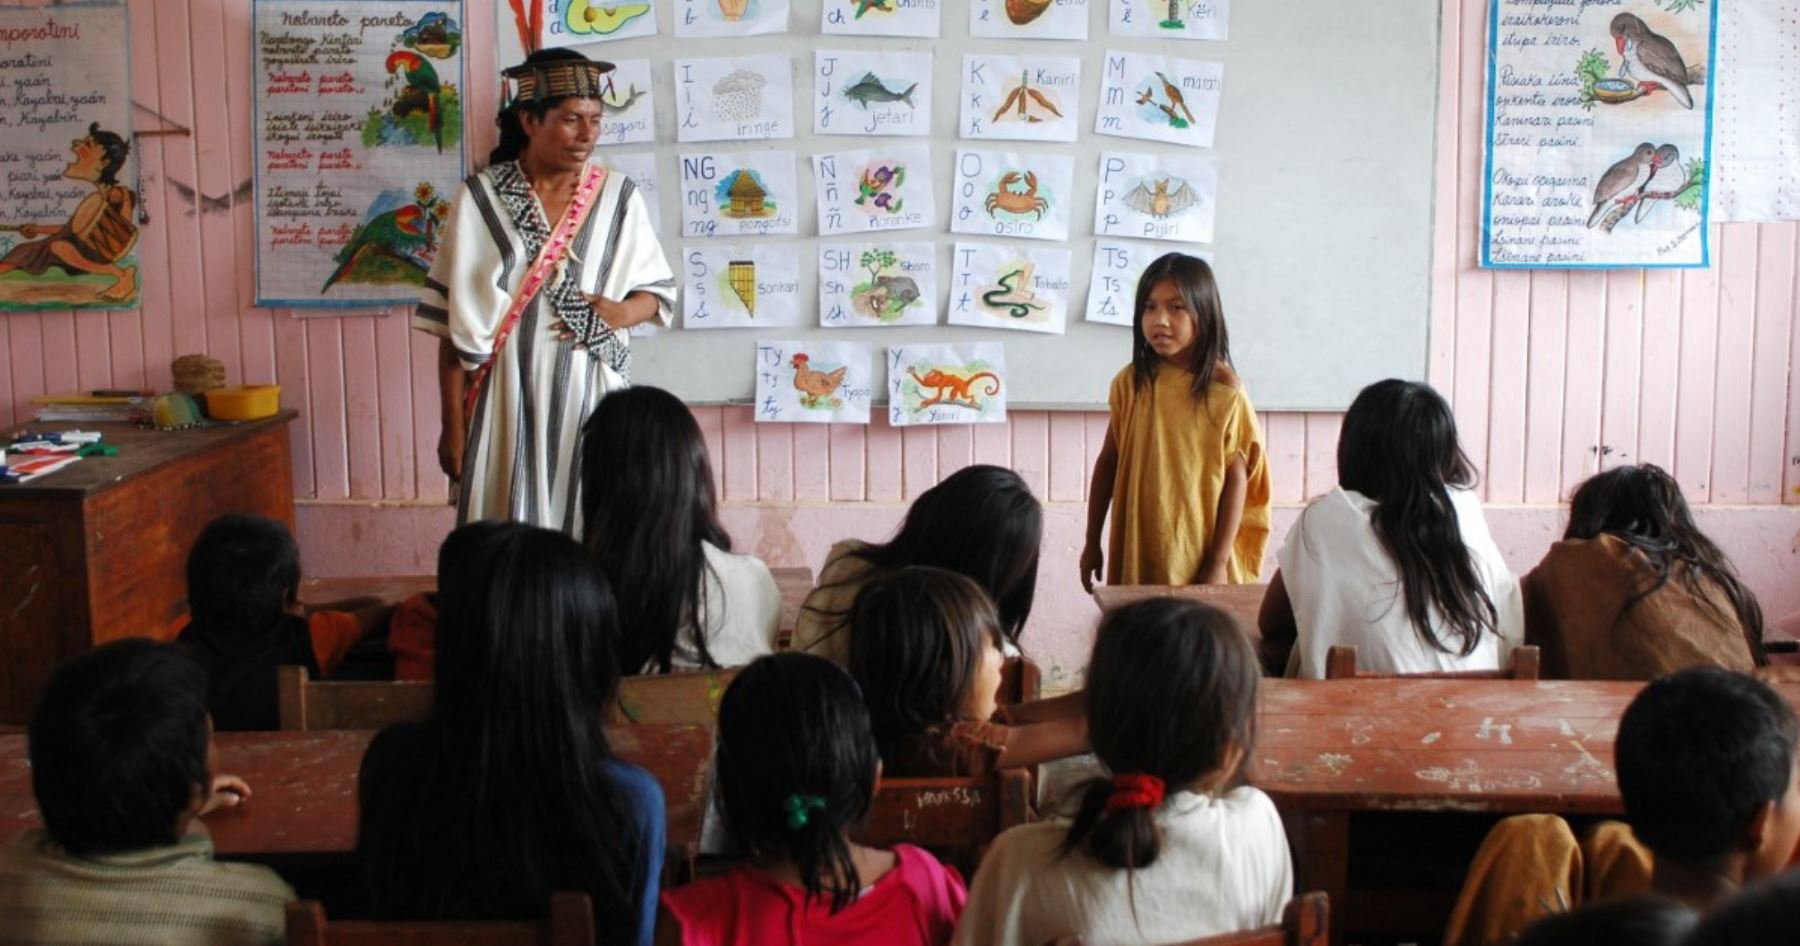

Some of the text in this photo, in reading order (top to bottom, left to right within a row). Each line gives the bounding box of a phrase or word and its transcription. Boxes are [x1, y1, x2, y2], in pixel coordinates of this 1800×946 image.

[686, 10, 698, 25] b
[828, 8, 846, 25] ch
[682, 65, 694, 83] I
[821, 58, 838, 77] J
[970, 61, 986, 84] K
[1108, 57, 1126, 79] M
[684, 156, 716, 180] NG
[961, 153, 982, 178] O
[1104, 157, 1126, 183] P
[688, 189, 709, 214] ng
[690, 220, 719, 237] ng
[689, 252, 708, 277] S
[823, 249, 850, 272] SH
[960, 249, 976, 268] T
[1102, 247, 1129, 269] TS
